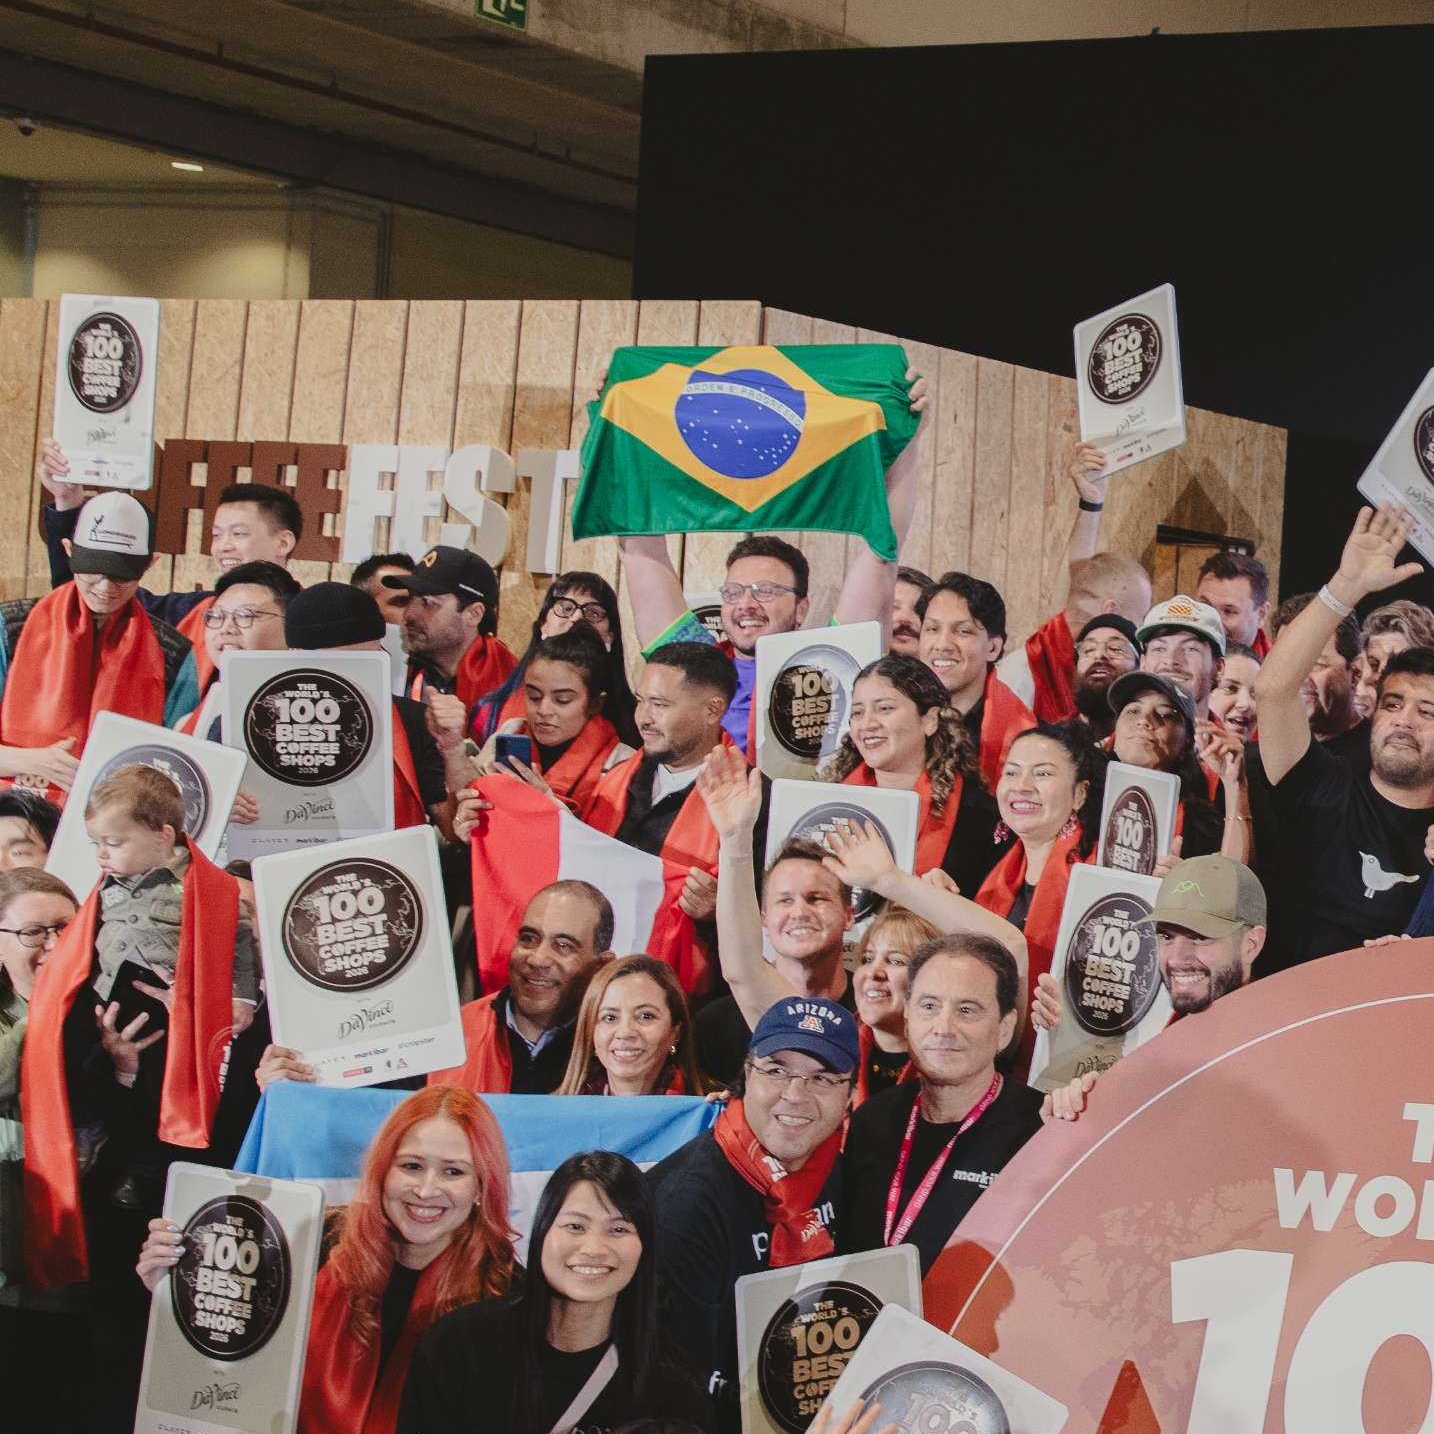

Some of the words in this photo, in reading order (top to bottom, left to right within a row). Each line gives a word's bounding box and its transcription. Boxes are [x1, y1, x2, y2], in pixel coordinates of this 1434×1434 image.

[86, 336, 124, 361] 100
[1104, 331, 1143, 360] 100
[83, 357, 123, 377] BEST
[1105, 349, 1143, 376] BEST
[1105, 362, 1144, 385] COFFEE
[1107, 373, 1141, 394] SHOPS
[686, 383, 723, 393] ORDEM
[730, 385, 735, 393] E
[741, 388, 801, 428] PROGRESSO
[297, 683, 317, 691] THE
[792, 671, 839, 698] 100
[275, 698, 341, 724] 100
[792, 694, 840, 716] BEST
[792, 712, 839, 727] COFFEE
[275, 723, 341, 742] BEST
[795, 724, 835, 740] SHOPS
[275, 742, 340, 755] COFFEE
[280, 755, 336, 767] SHOPS
[284, 799, 337, 824] DaVinci
[1115, 817, 1143, 851] 100
[1112, 849, 1141, 871] BEST
[334, 873, 358, 884] THE
[313, 886, 385, 923] 100
[1113, 909, 1130, 920] THE
[316, 913, 388, 945] BEST
[318, 935, 389, 959] COFFEE
[1092, 924, 1141, 962] 100
[324, 949, 387, 973] SHOPS
[1085, 954, 1136, 985] BEST
[1082, 978, 1131, 1000] COFFEE
[787, 1004, 842, 1026] ARIZONA
[1082, 993, 1124, 1014] SHOPS
[338, 1000, 395, 1040] DaVinci
[798, 1015, 824, 1034] A
[226, 1215, 244, 1226] THE
[201, 1232, 261, 1275] 100
[196, 1268, 257, 1302] BEST
[194, 1292, 252, 1320] COFFEE
[813, 1301, 834, 1311] THE
[195, 1310, 246, 1336] SHOPS
[792, 1316, 860, 1357] 100
